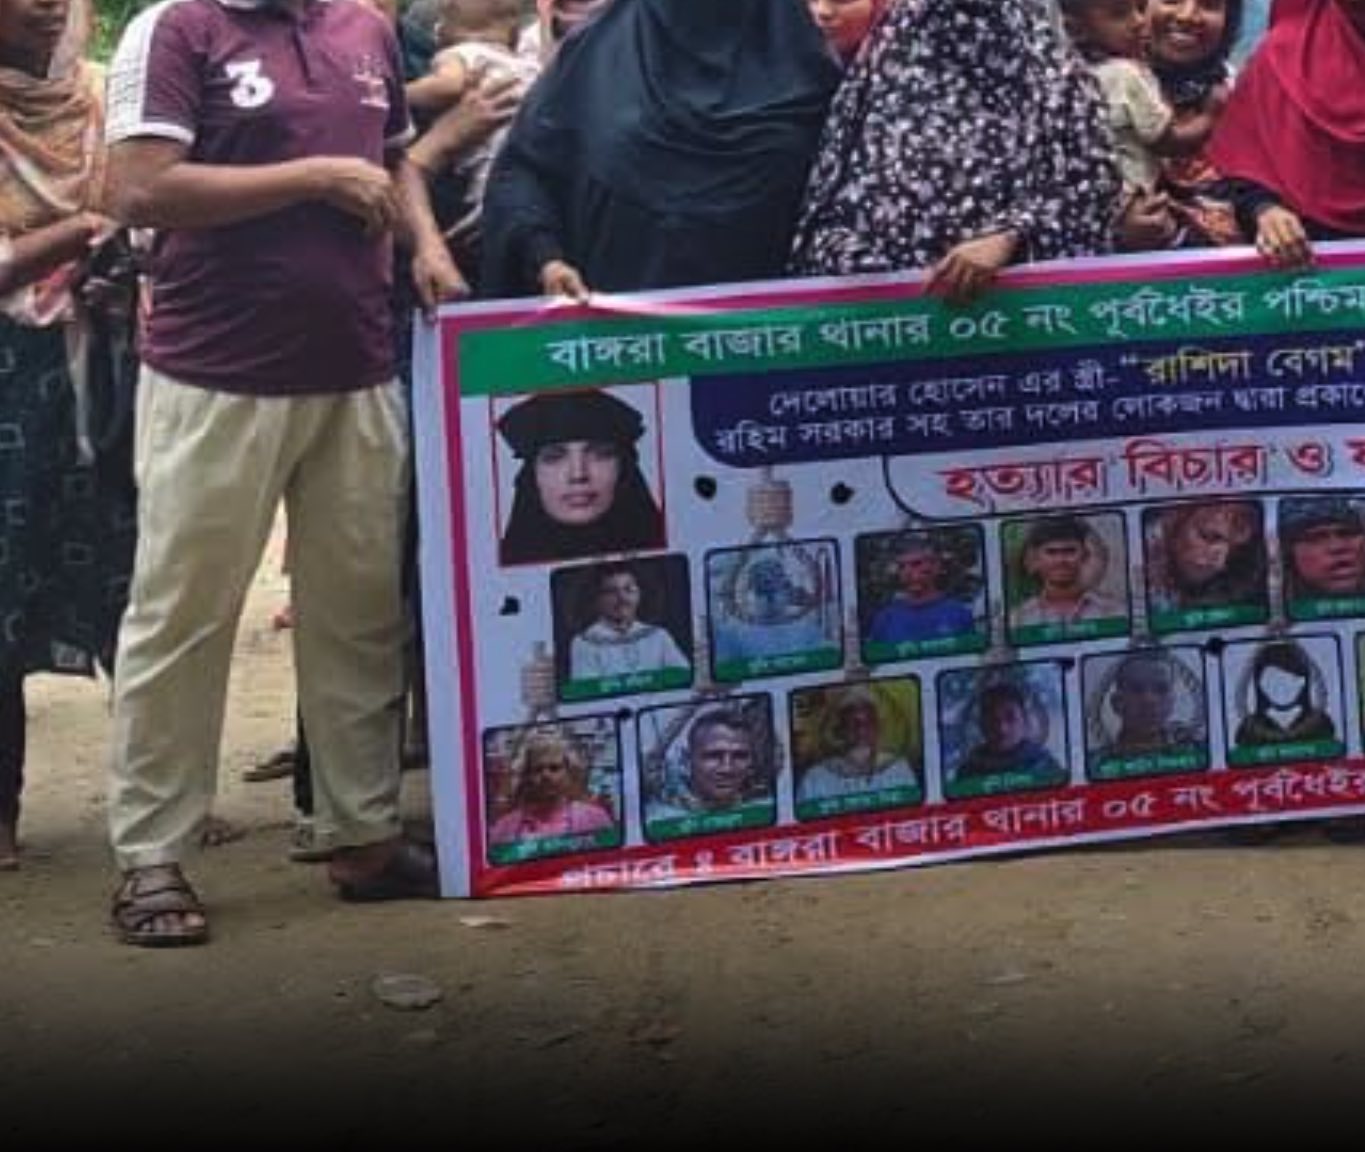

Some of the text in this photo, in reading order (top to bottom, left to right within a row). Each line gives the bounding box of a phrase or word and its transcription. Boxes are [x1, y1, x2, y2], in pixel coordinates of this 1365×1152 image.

[225, 59, 274, 108] 3
[546, 332, 666, 374] বাঙ্গরা
[676, 321, 802, 361] বাজার
[819, 313, 929, 349] থানার
[950, 311, 1012, 340] ০৫
[1023, 304, 1077, 335] নং
[908, 373, 1007, 406] হোসেন
[1018, 367, 1063, 395] এর
[714, 419, 786, 454] রহিম
[799, 414, 894, 445] সরকার
[908, 410, 952, 437] সহ
[960, 404, 1013, 432] তার
[1025, 398, 1097, 428] দলের
[1112, 393, 1224, 422] লোকজন
[939, 454, 1105, 504] হত্যার
[1122, 439, 1266, 490] বিচার
[1287, 441, 1332, 476] ও
[856, 814, 969, 854] বাজার
[982, 797, 1083, 835] থানার
[1101, 791, 1157, 818] ০৫
[1173, 783, 1216, 811] নং
